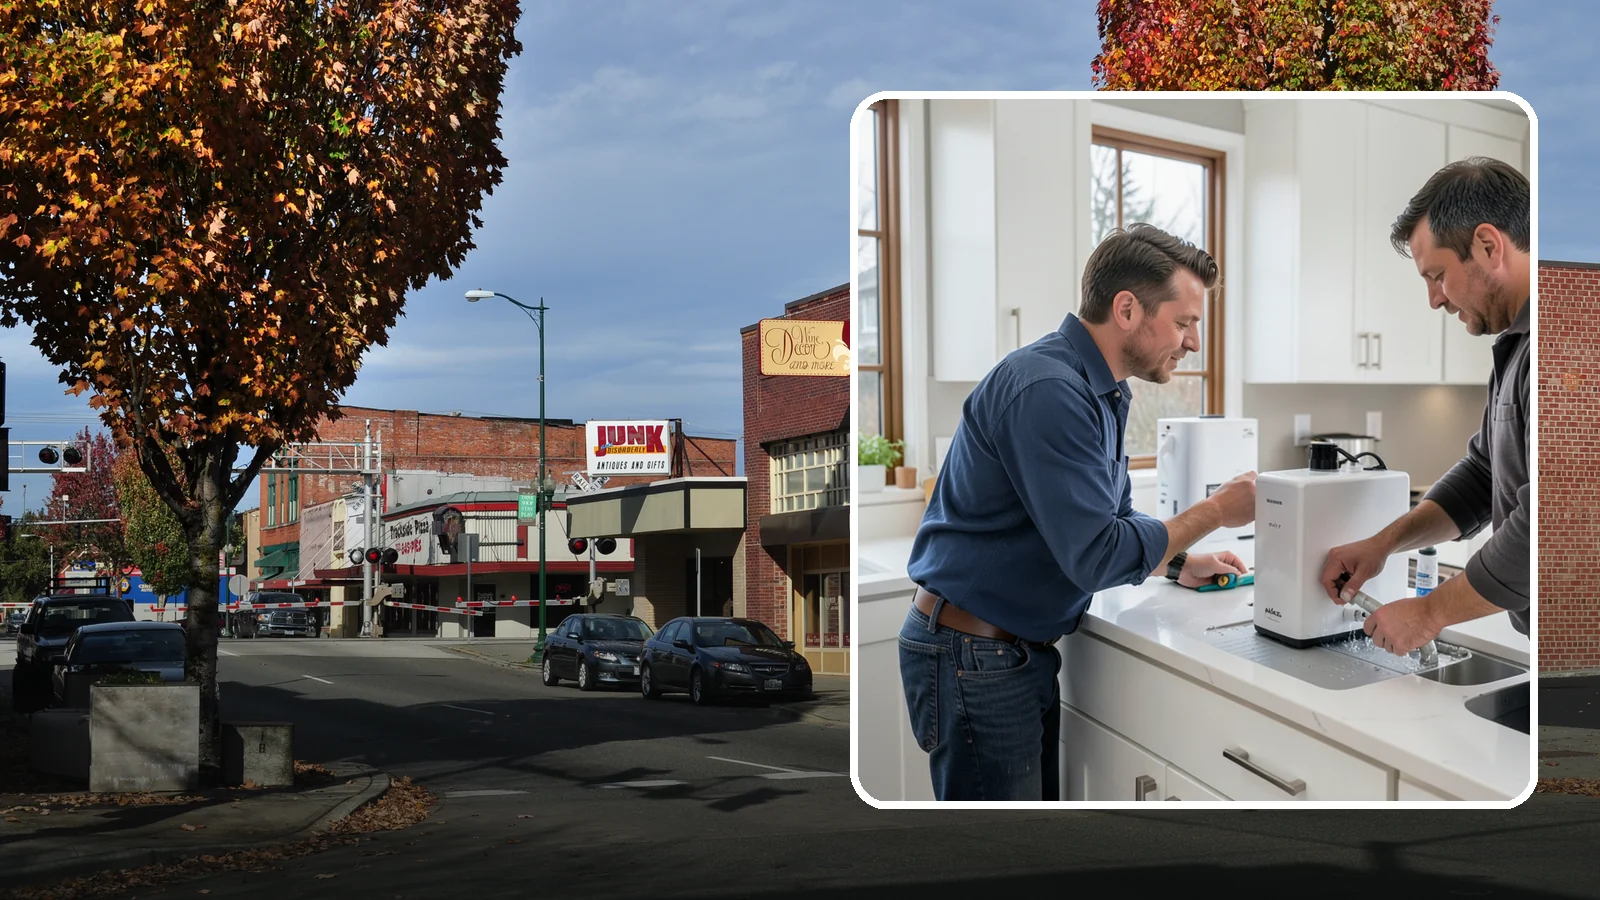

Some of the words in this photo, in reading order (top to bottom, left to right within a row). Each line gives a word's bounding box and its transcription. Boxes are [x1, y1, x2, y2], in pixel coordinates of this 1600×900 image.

[595, 425, 665, 457] JUNK
[607, 446, 646, 454] DISORDERLY
[596, 461, 628, 470] ANTIQUES
[631, 461, 644, 470] AND
[646, 460, 665, 469] GIFTS
[573, 473, 589, 492] RAIL
[390, 521, 413, 540] Trackside
[414, 520, 429, 535] Pizza
